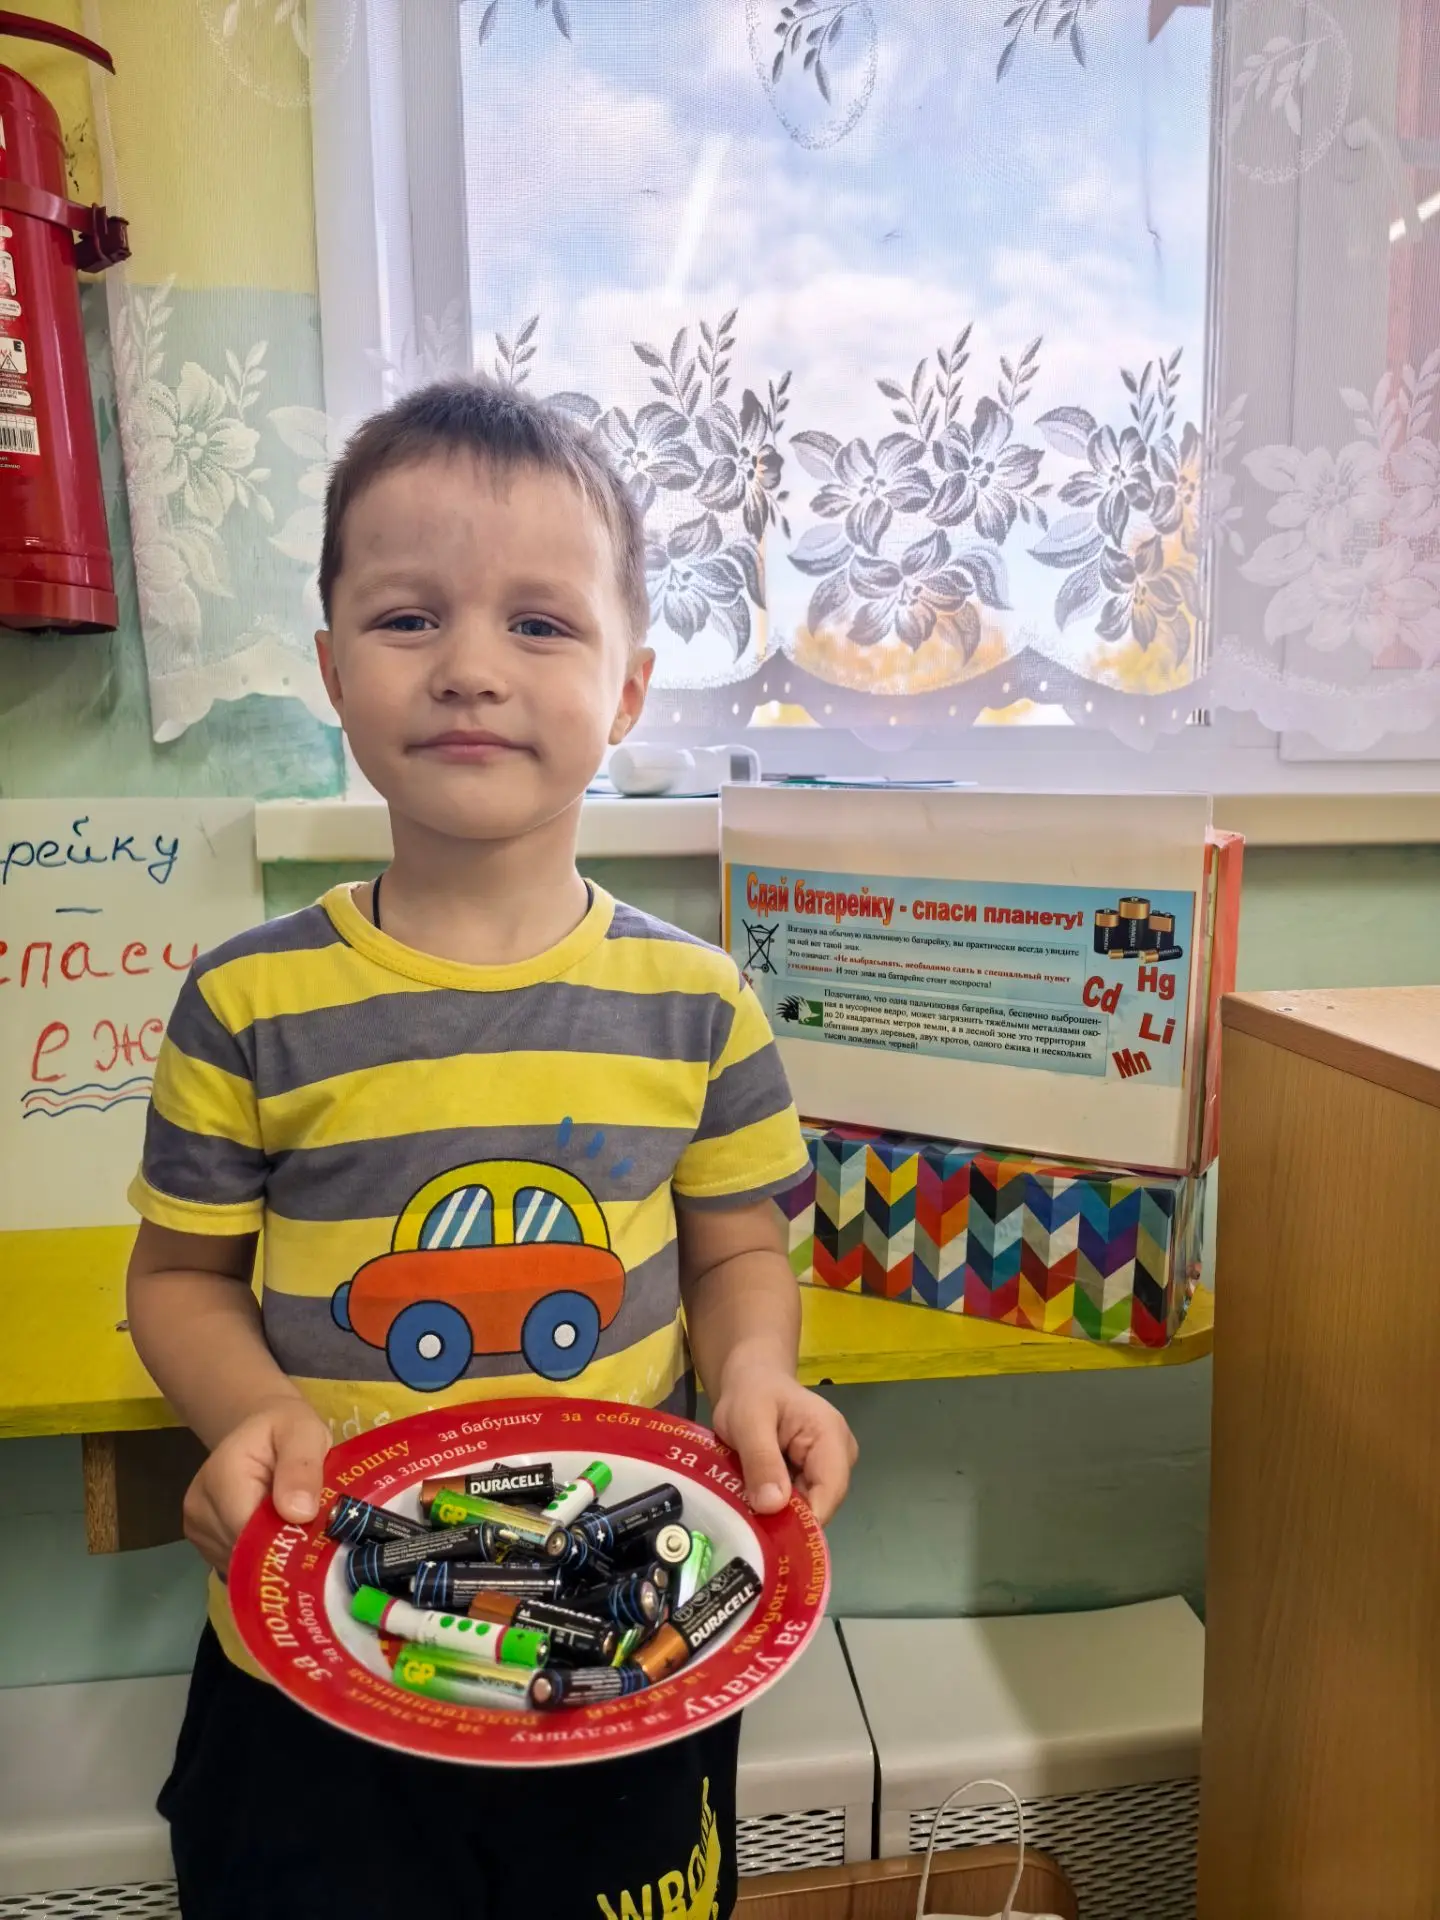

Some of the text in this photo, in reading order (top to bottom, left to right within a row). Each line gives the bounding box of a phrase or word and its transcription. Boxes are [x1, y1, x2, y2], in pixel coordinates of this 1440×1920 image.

[0, 815, 179, 885] рейку
[746, 872, 790, 918] Сдай
[794, 879, 895, 926] батарейку
[912, 900, 976, 922] спаси
[984, 906, 1084, 930] планету!
[823, 942, 842, 950] такой
[966, 941, 1016, 952] практически
[1018, 945, 1044, 954] всегда
[1044, 948, 1080, 957] увидите
[836, 966, 842, 974] И
[950, 978, 992, 988] неспроста!
[984, 970, 1042, 980] специальный
[1044, 974, 1070, 984] пункт
[1082, 976, 1123, 1015] Cd
[1138, 966, 1176, 1000] Hg
[824, 988, 1102, 1026] Подсчитано, что одна пальчиковая батарейка, беспечно выброшен-
[846, 1004, 881, 1014] мусорное
[884, 1008, 908, 1017] ведро,
[938, 1014, 983, 1026] загрязнить
[986, 1020, 1029, 1030] тяжёлыми
[1032, 1025, 1080, 1035] металлами
[824, 1020, 859, 1032] обитания
[860, 1025, 878, 1034] двух
[880, 1029, 917, 1040] деревьев,
[920, 1033, 938, 1042] двух
[940, 1036, 970, 1047] кротов,
[973, 1040, 1002, 1049] одного
[1004, 1042, 1030, 1053] ёжика
[1042, 1048, 1092, 1060] нескольких
[824, 1032, 846, 1040] тысяч
[888, 1040, 918, 1050] червей!
[834, 1010, 844, 1019] 20
[846, 1014, 890, 1026] квадратных
[892, 1020, 920, 1030] метров
[924, 1024, 949, 1033] земли,
[966, 1028, 995, 1037] лесной
[998, 1032, 1016, 1040] зоне
[1036, 1035, 1086, 1047] территория
[1138, 1013, 1176, 1044] Li
[31, 1018, 164, 1082] еж
[1112, 1048, 1152, 1078] Mn
[438, 1411, 543, 1443] за бабушку
[560, 1411, 582, 1422] за
[596, 1410, 641, 1426] себя
[336, 1439, 410, 1487] кошку
[373, 1438, 488, 1490] за здоровье
[665, 1446, 757, 1515] за ма
[470, 1473, 544, 1494] DURACELL
[301, 1554, 318, 1571] за
[804, 1532, 826, 1607] красивую
[260, 1522, 332, 1681] за подружку
[690, 1586, 754, 1647] DURACELL
[733, 1555, 789, 1656] за любовь
[296, 1591, 342, 1664] за работу
[403, 1660, 436, 1684] GP
[682, 1620, 807, 1720] за удачу
[510, 1722, 632, 1744] дедушку
